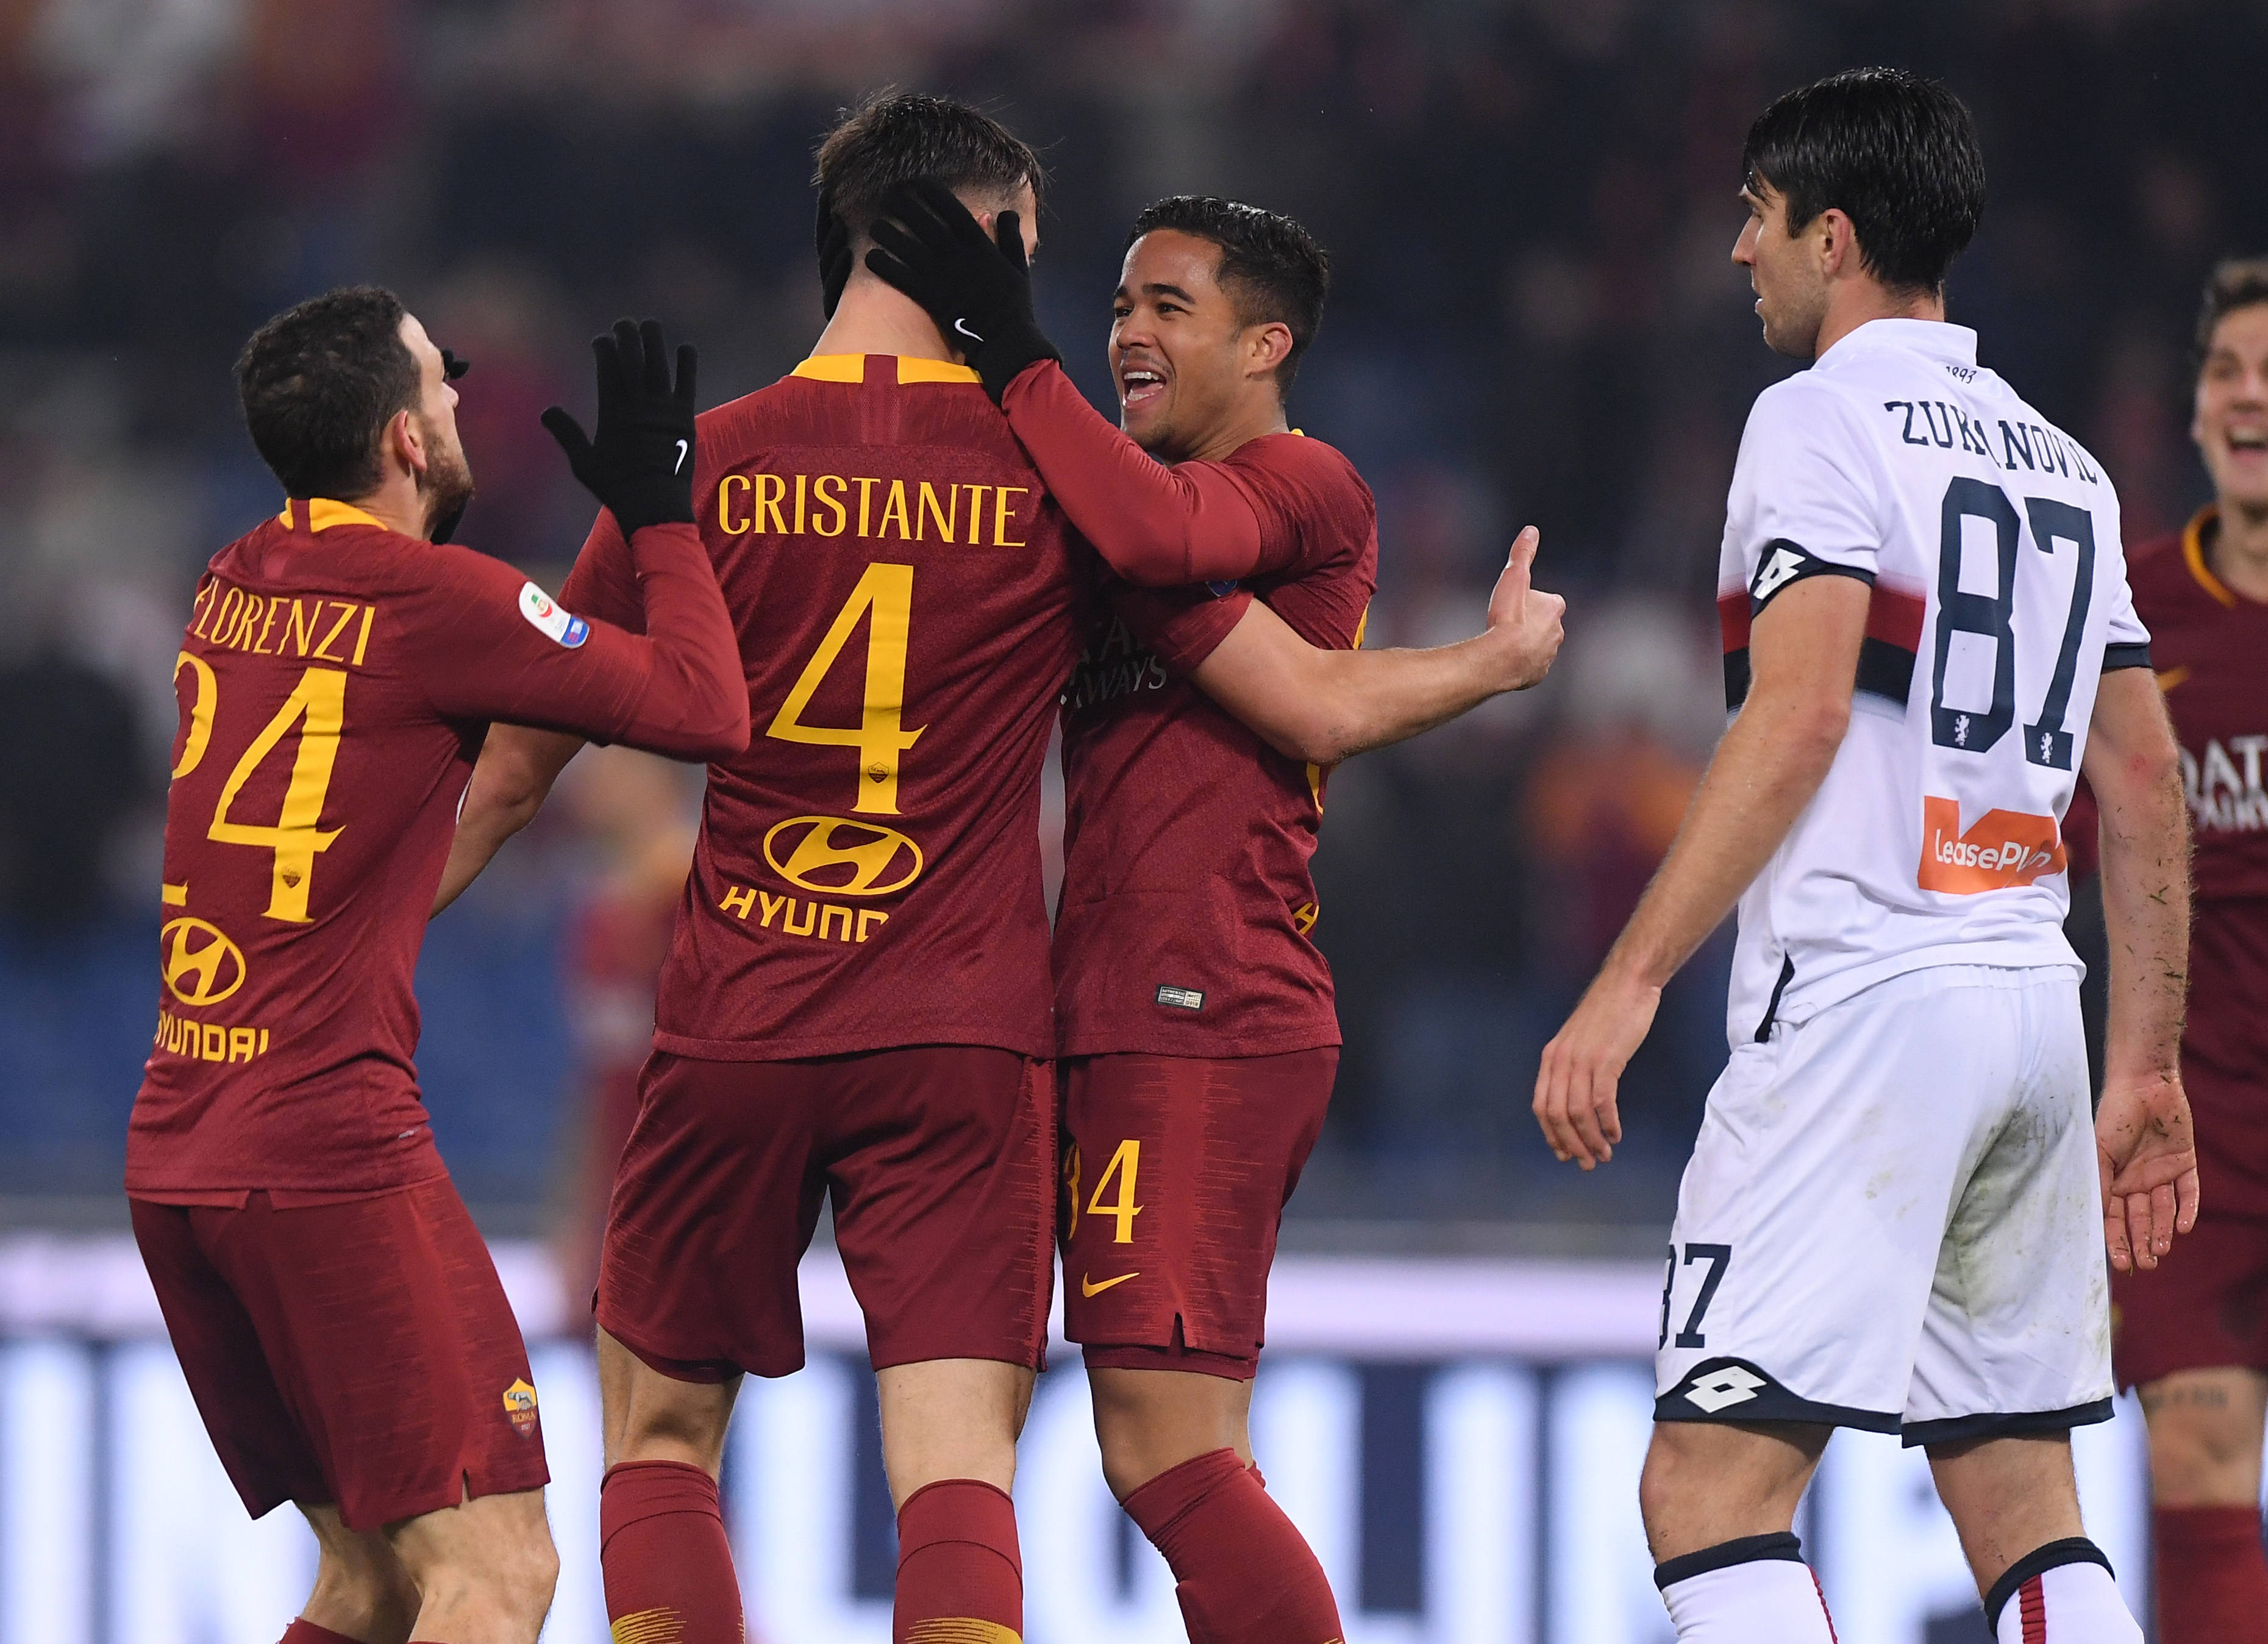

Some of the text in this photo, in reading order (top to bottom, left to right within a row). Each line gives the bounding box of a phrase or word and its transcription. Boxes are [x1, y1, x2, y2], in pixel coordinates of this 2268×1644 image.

[718, 474, 1029, 547] CRISTANTE
[766, 562, 928, 815] 4
[1930, 476, 2096, 771] 87
[1935, 828, 2052, 873] LeasePln
